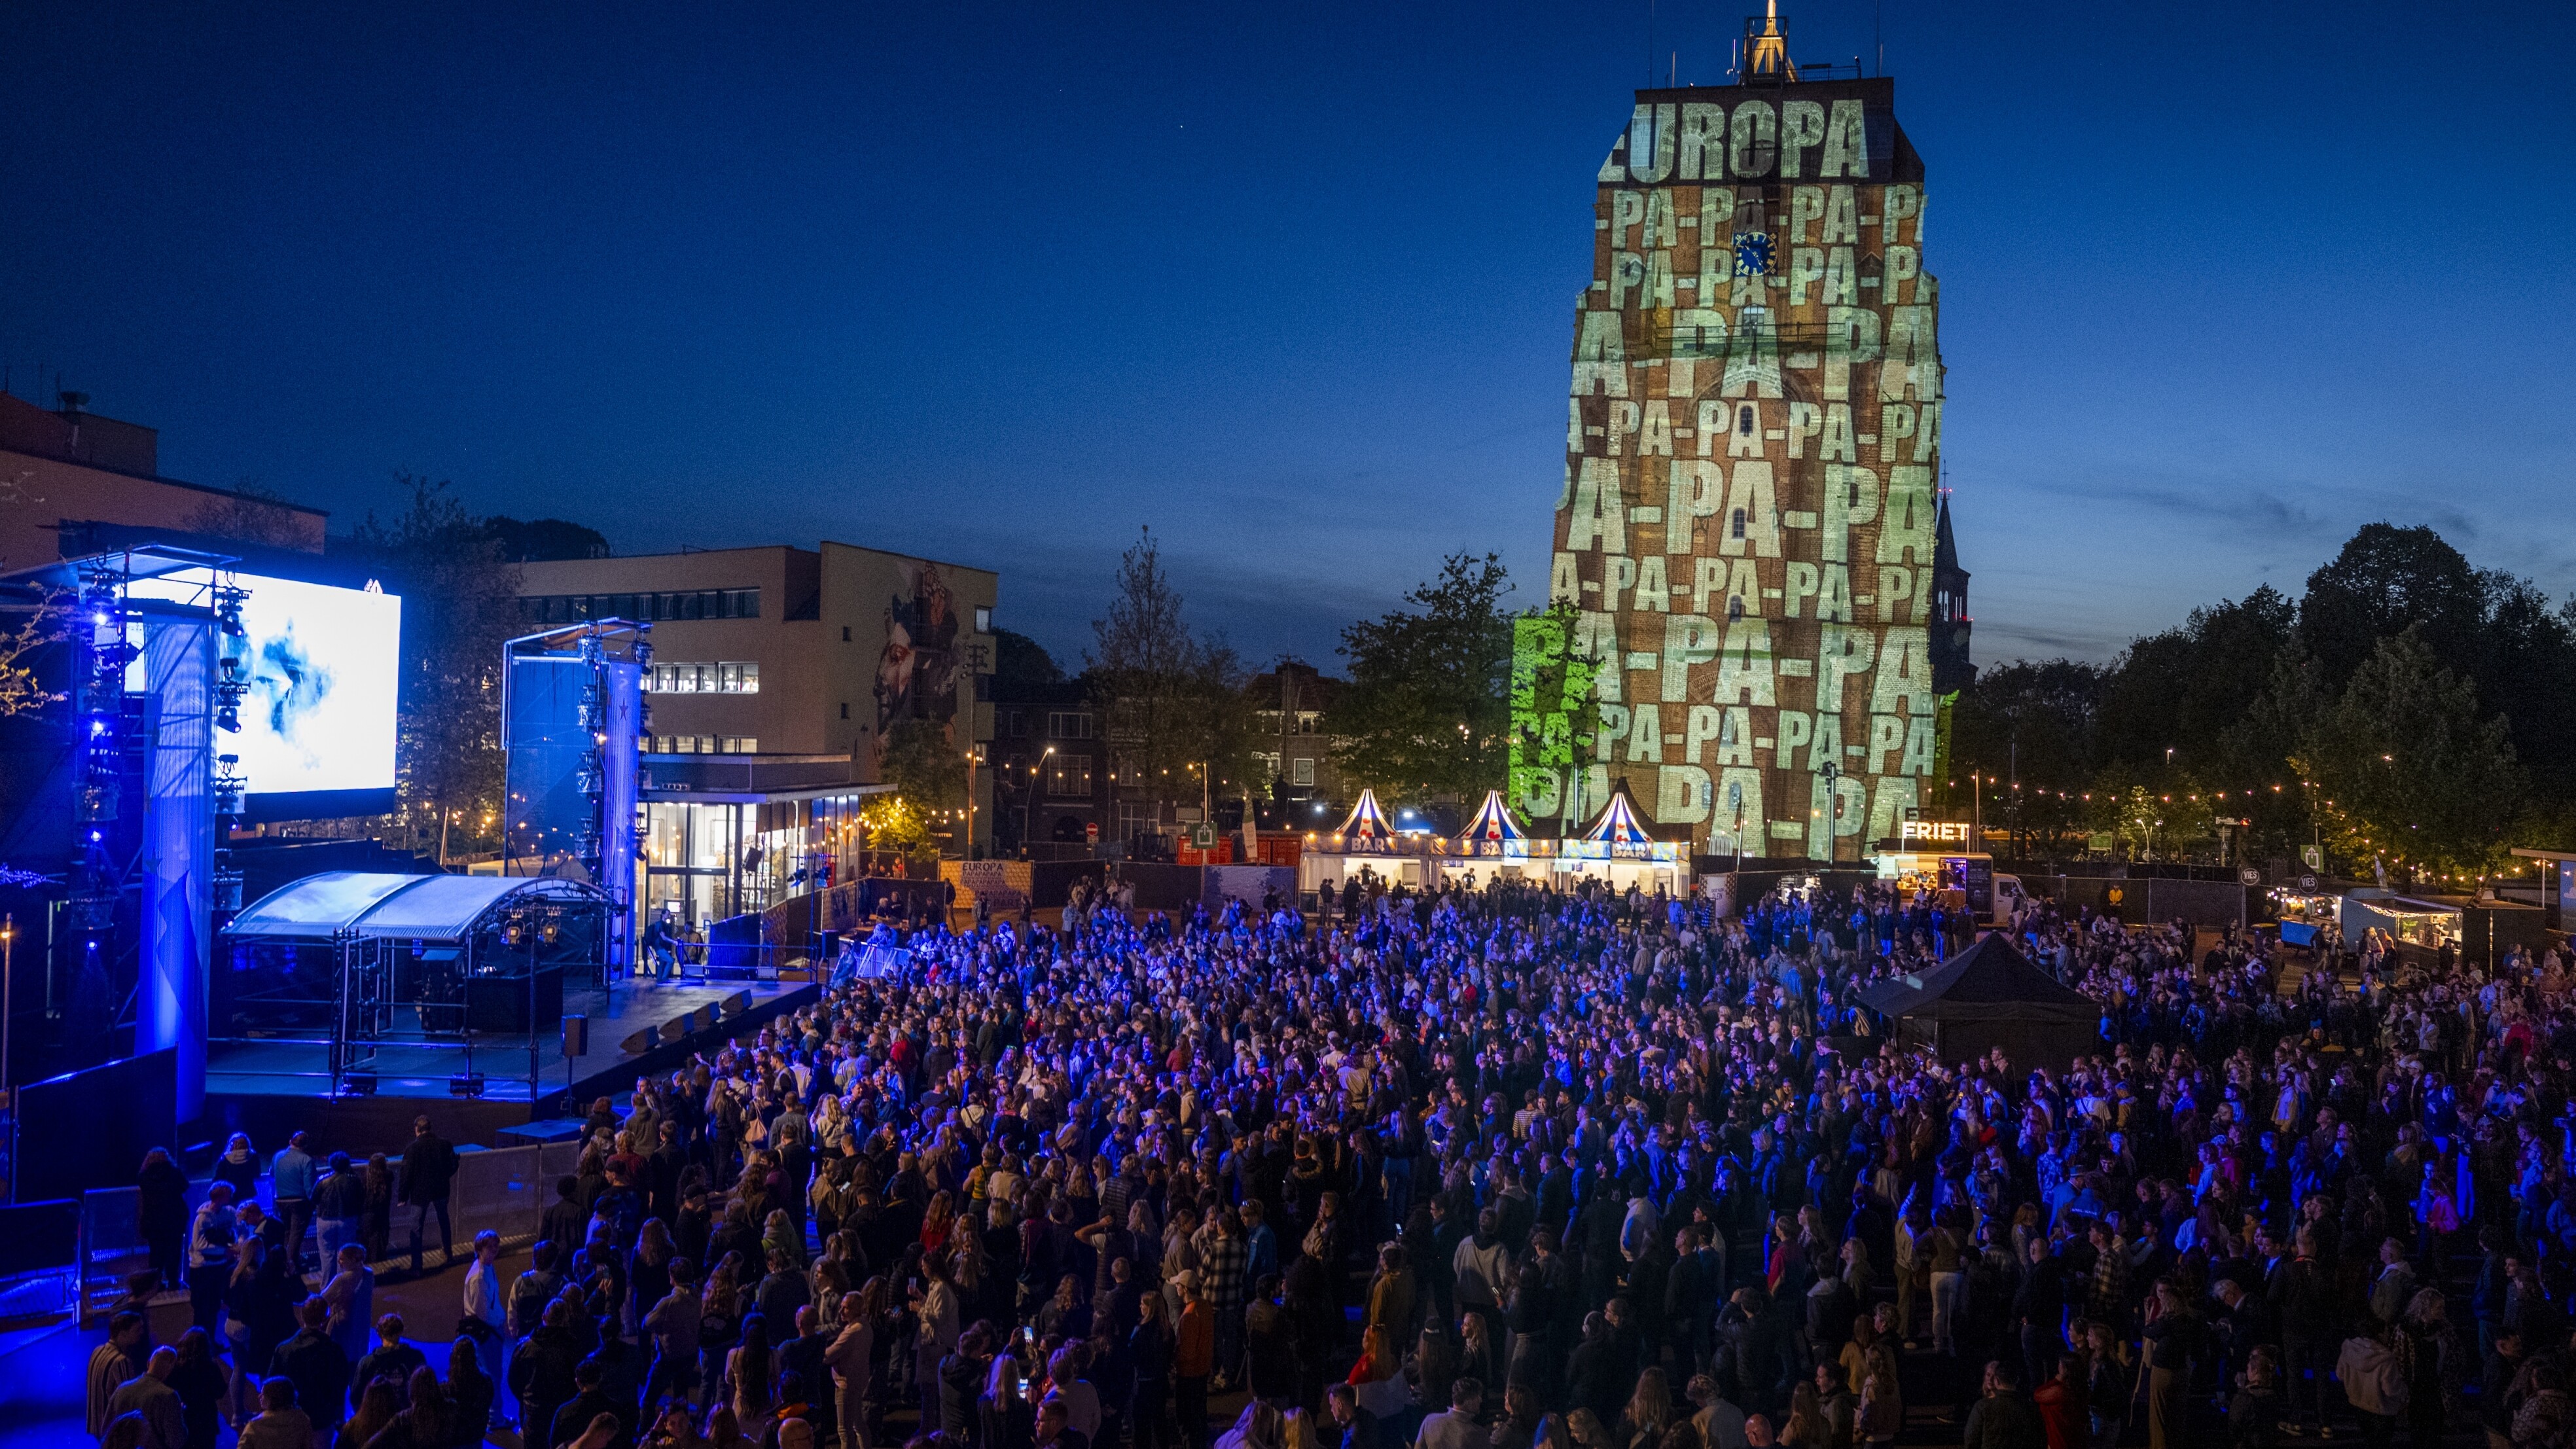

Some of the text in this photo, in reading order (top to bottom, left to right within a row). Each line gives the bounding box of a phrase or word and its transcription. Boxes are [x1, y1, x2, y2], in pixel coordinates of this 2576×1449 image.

[1902, 821, 1970, 841] FRIET
[1351, 837, 1385, 851] BAR
[1480, 841, 1515, 856] BAR
[1612, 842, 1646, 857] BAR
[962, 862, 1004, 872] EUROPA
[2244, 870, 2257, 880] VIES
[2301, 878, 2316, 887] VIES
